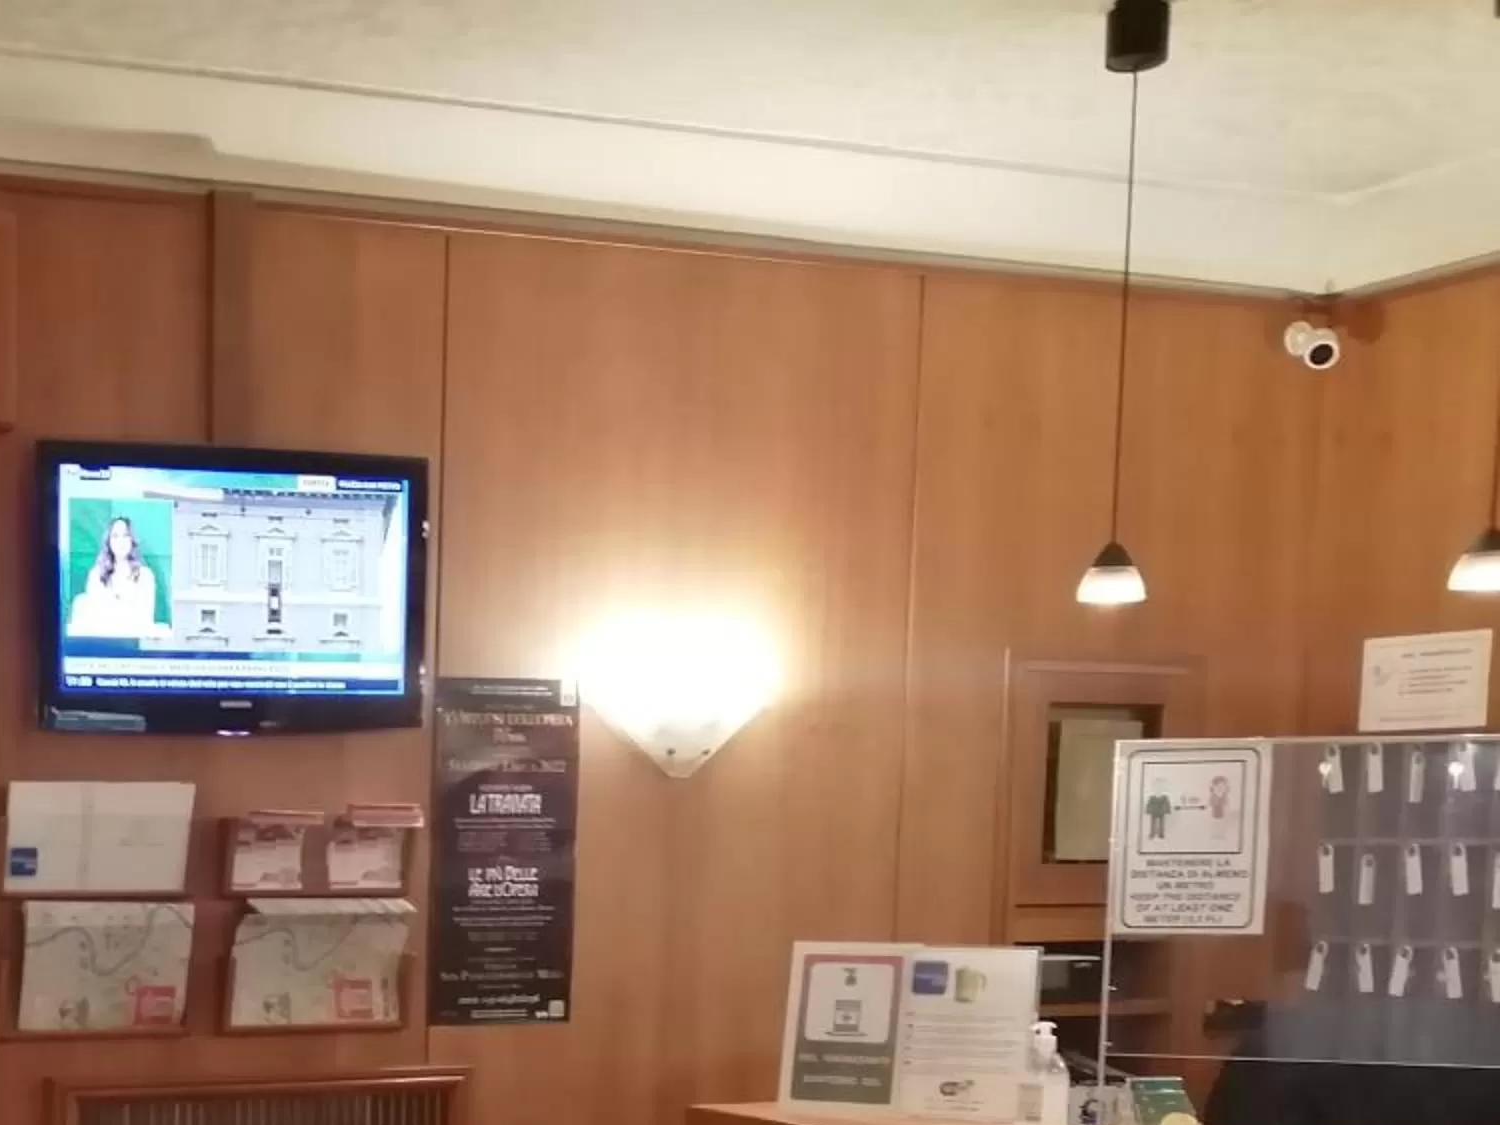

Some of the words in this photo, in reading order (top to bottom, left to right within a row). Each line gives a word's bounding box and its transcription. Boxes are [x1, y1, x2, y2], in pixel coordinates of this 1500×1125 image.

[469, 793, 487, 814] LA
[1146, 858, 1213, 867] MANTENERE
[1216, 858, 1231, 867] LA
[1130, 869, 1184, 879] DISTANZA
[1174, 881, 1214, 890] METRO
[1135, 903, 1151, 912] OF
[1153, 903, 1169, 912] AT
[1171, 903, 1206, 913] LEAST
[1209, 903, 1234, 913] ONE
